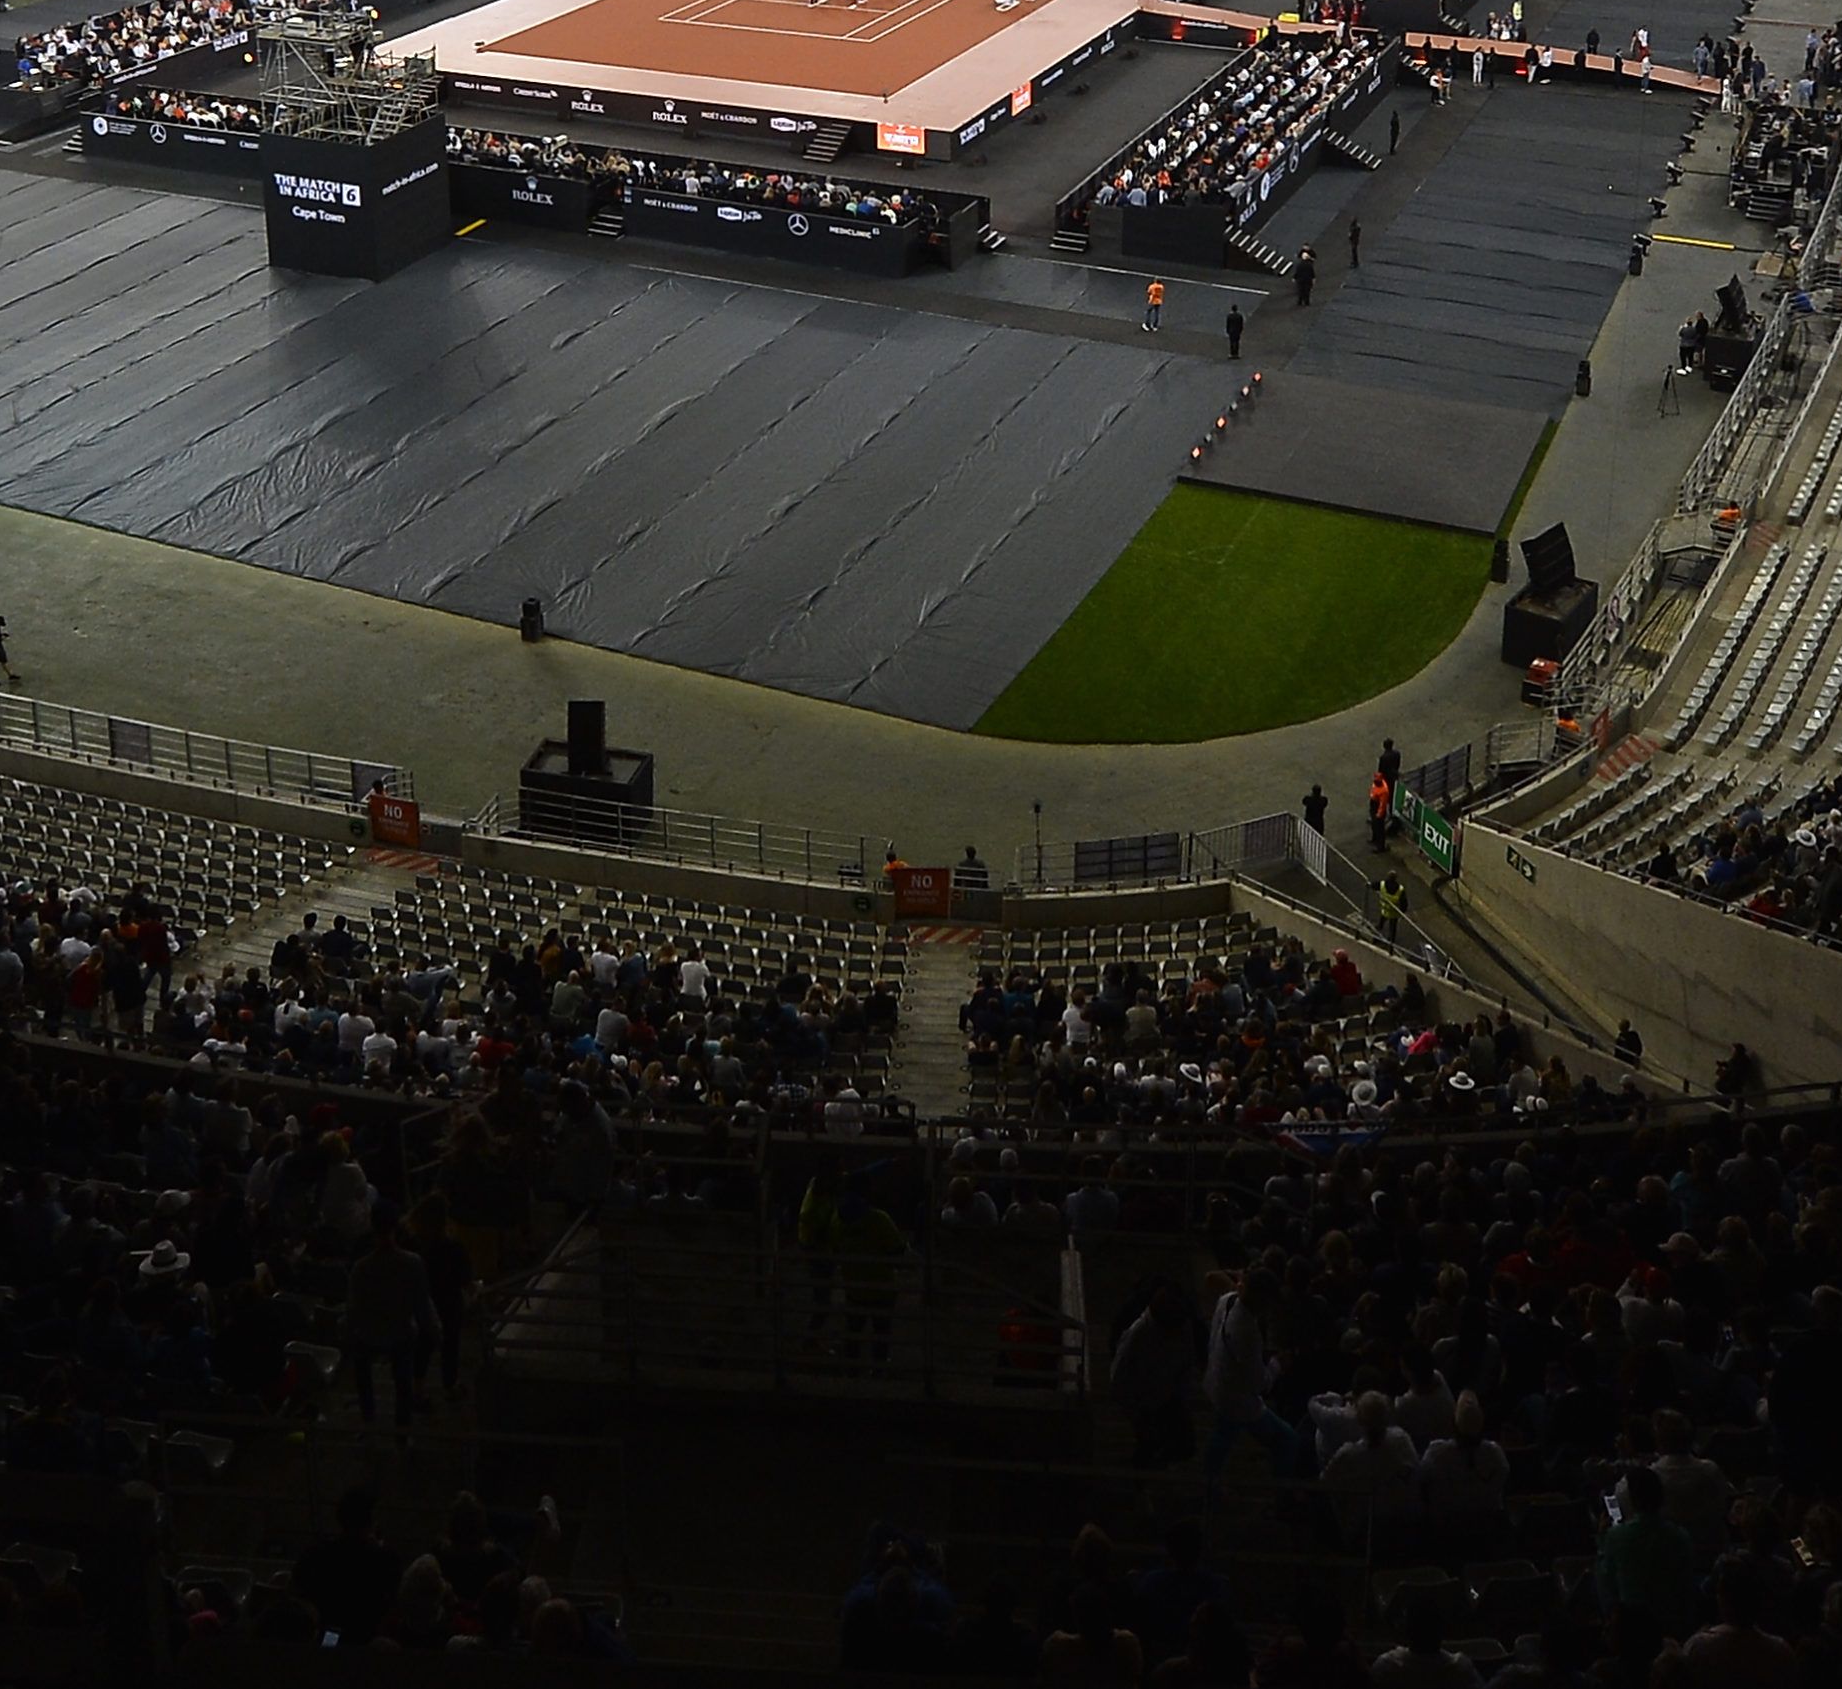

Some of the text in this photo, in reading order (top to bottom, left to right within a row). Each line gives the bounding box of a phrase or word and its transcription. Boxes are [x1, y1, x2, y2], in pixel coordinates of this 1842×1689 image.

[571, 101, 605, 113] ROLEX
[652, 111, 688, 124] ROLEX
[274, 173, 341, 194] THE MATCH
[279, 184, 336, 203] IN AFRICA
[512, 189, 554, 205] ROLEX
[292, 205, 346, 224] Cape Town
[384, 803, 403, 820] NO
[1424, 821, 1450, 856] EXIT
[910, 874, 933, 889] NO
